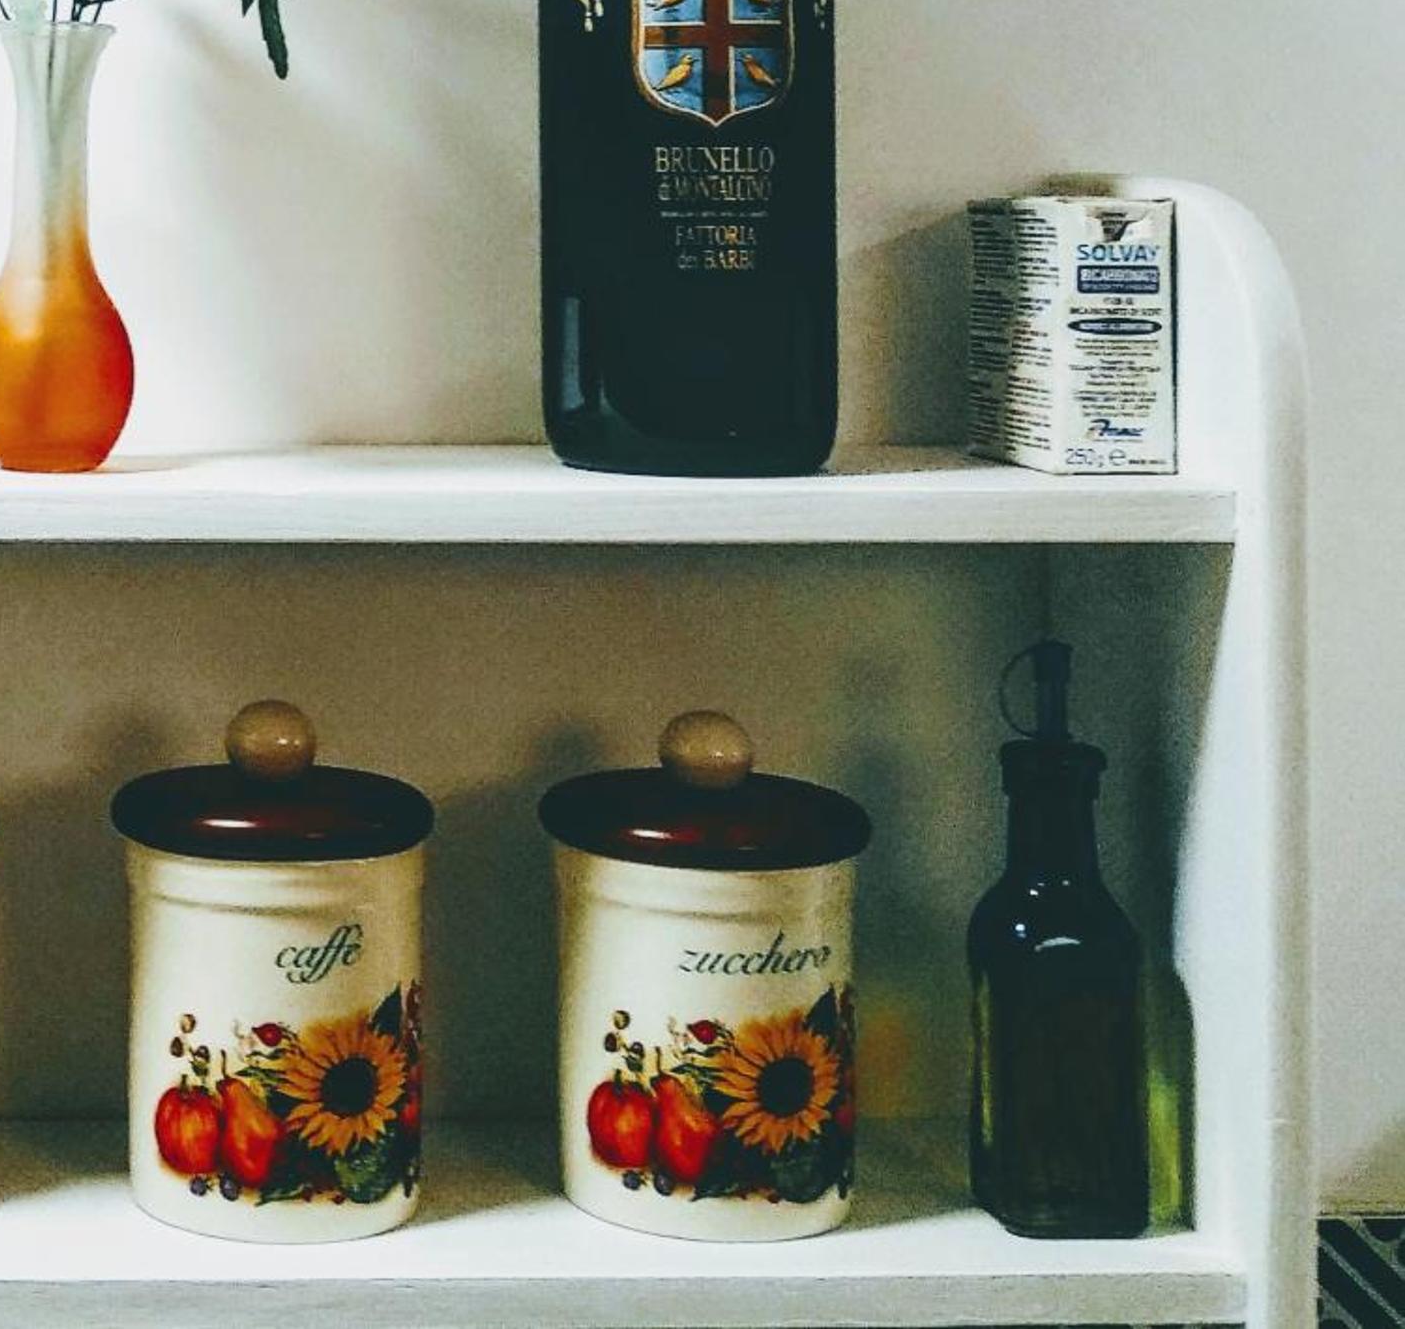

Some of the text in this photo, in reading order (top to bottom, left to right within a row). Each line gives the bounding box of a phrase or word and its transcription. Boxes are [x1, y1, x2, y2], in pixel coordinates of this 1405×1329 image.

[654, 146, 775, 173] BRUNELLO
[1077, 244, 1161, 262] SOLVAY
[678, 928, 833, 975] zucchero
